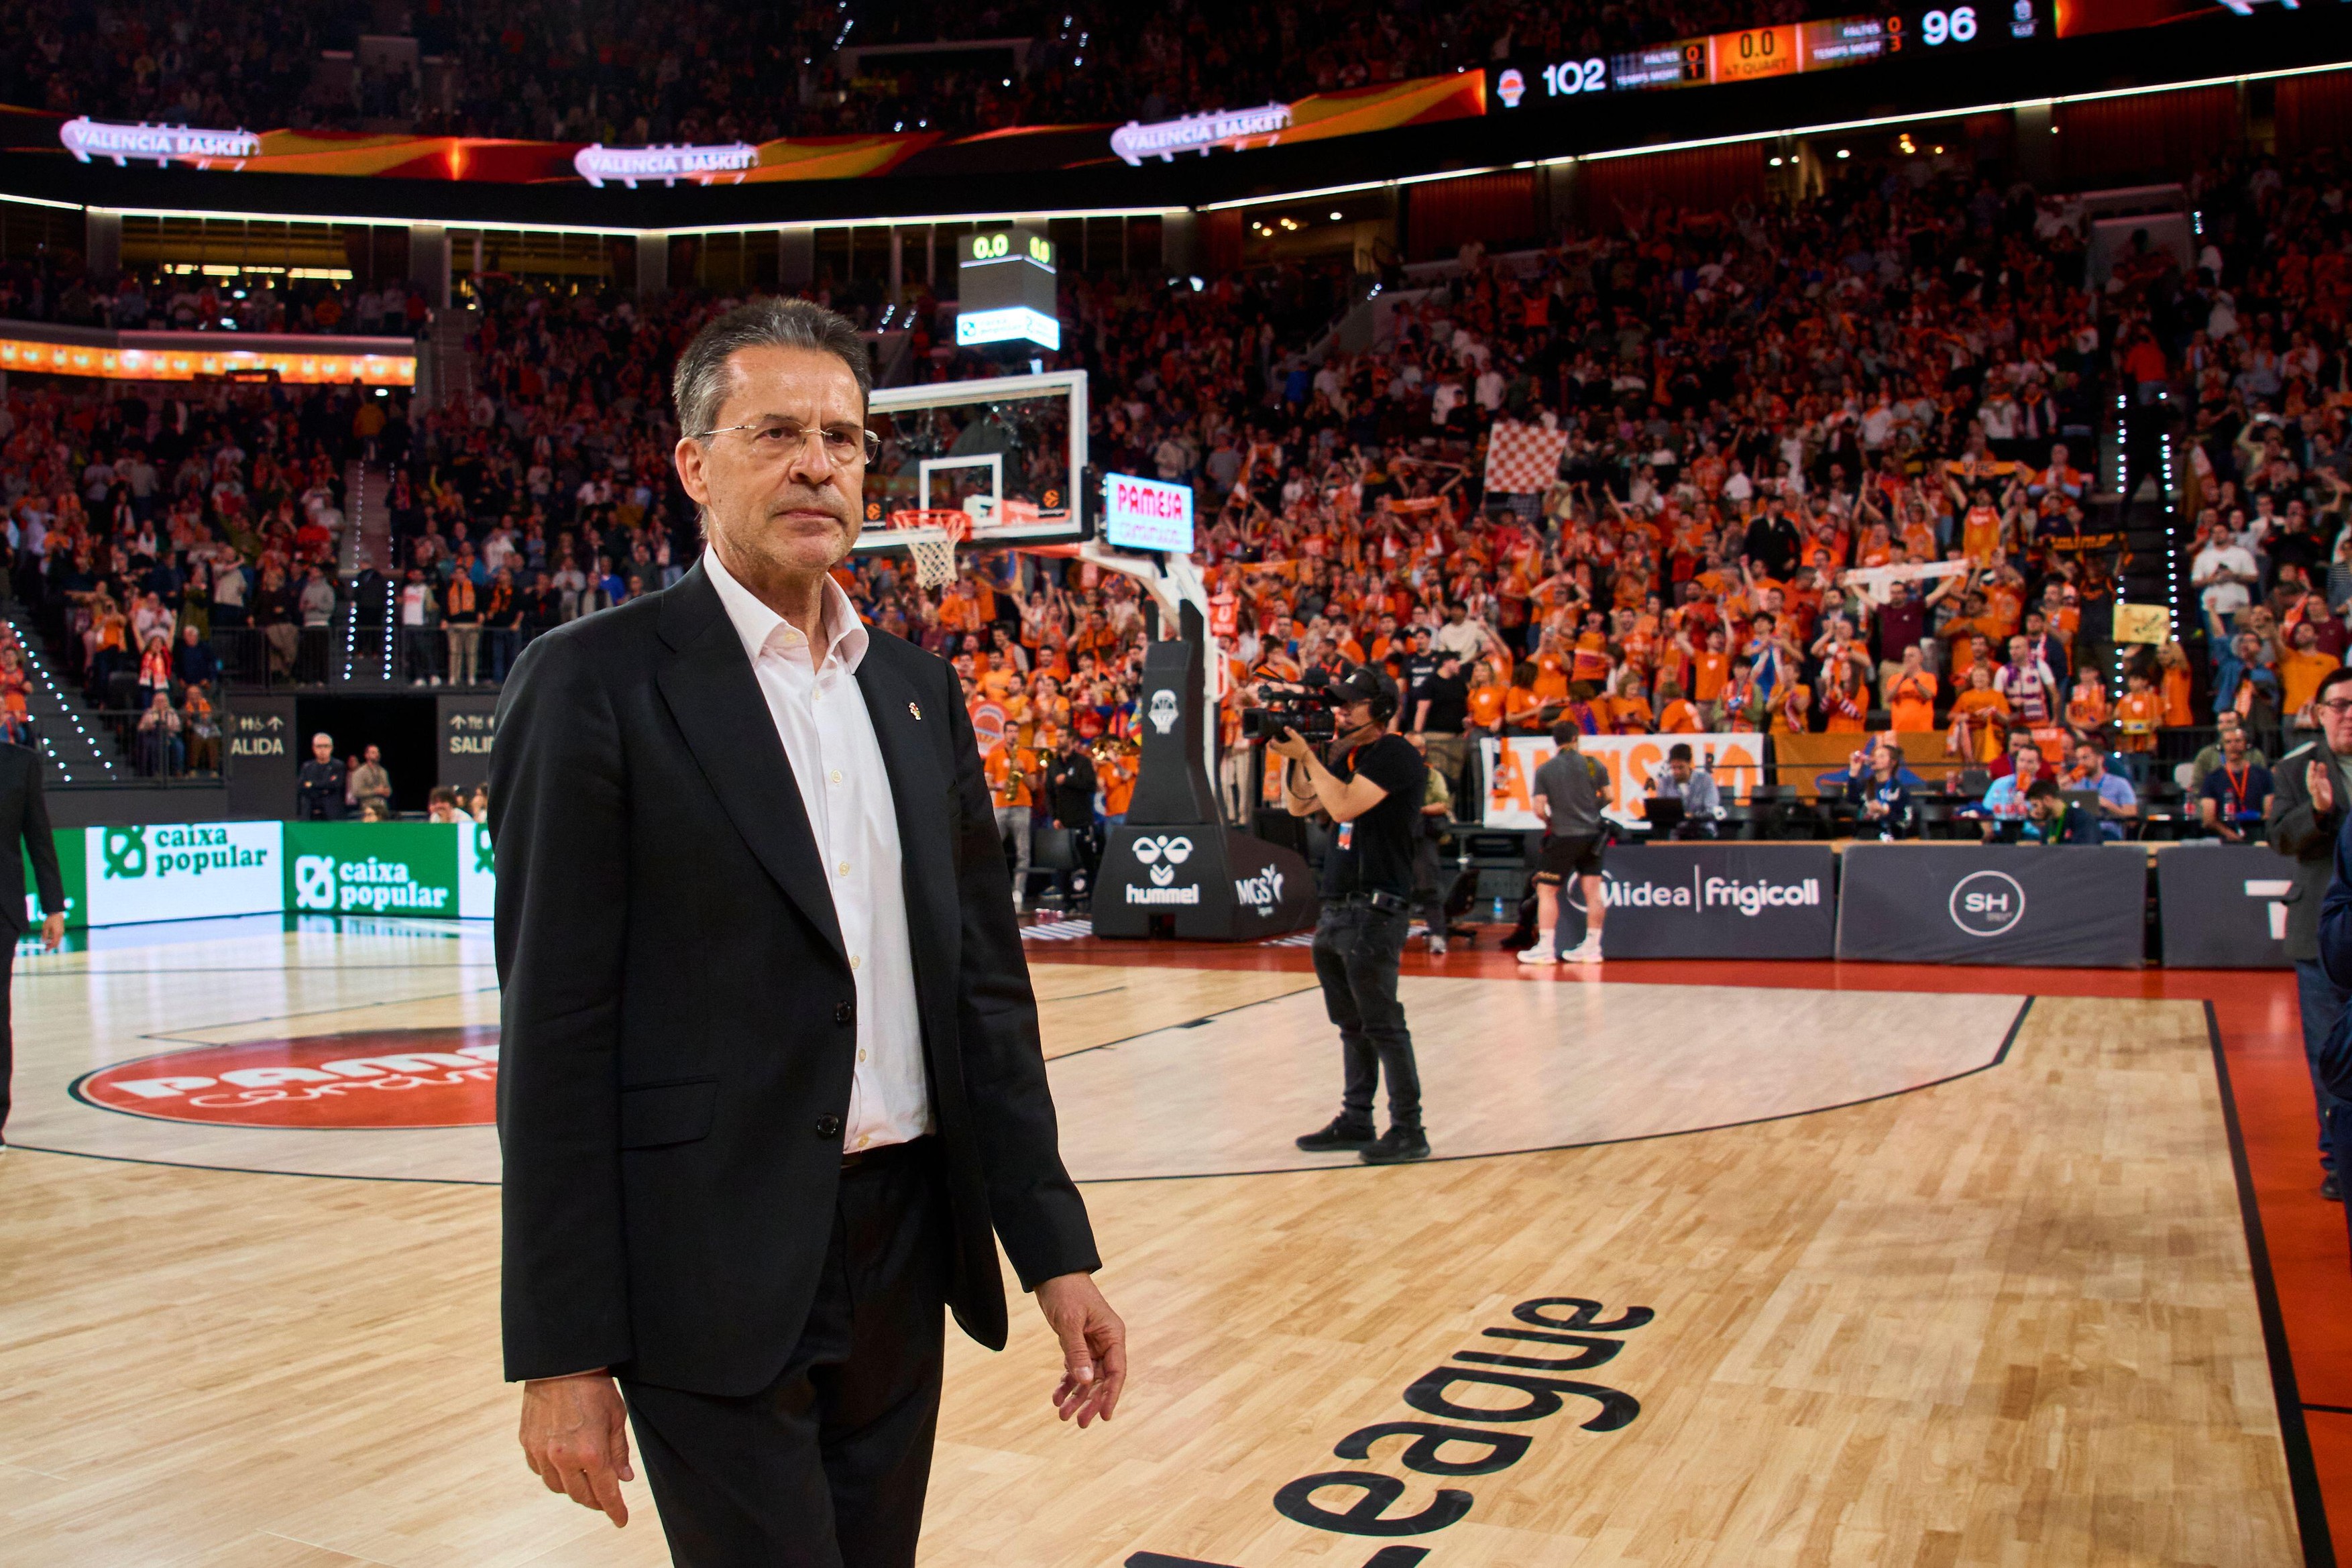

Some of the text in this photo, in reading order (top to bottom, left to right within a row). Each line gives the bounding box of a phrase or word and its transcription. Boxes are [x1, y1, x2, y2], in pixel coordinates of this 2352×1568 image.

[1887, 16, 1902, 33] 0
[1921, 6, 1977, 46] 96
[1685, 46, 1699, 62] 0
[1740, 30, 1774, 58] 0.0
[1890, 36, 1903, 52] 3
[1543, 58, 1606, 97] 102
[1688, 64, 1698, 78] 1
[74, 129, 254, 156] VALENCIA BASKET
[1124, 115, 1284, 150] VALENCIA BASKET
[588, 154, 752, 172] VALENCIA BASKET
[973, 234, 1009, 259] 0.0
[1117, 484, 1183, 520] PAMESA
[231, 738, 284, 755] ALIDA
[155, 826, 227, 847] caixa
[156, 845, 268, 878] popular
[339, 856, 409, 883] caixa
[340, 881, 449, 911] popular
[1125, 883, 1200, 904] hummel
[1705, 877, 1819, 916] frigicoll
[1964, 893, 2009, 912] SH
[1123, 1296, 1656, 1568] eague
